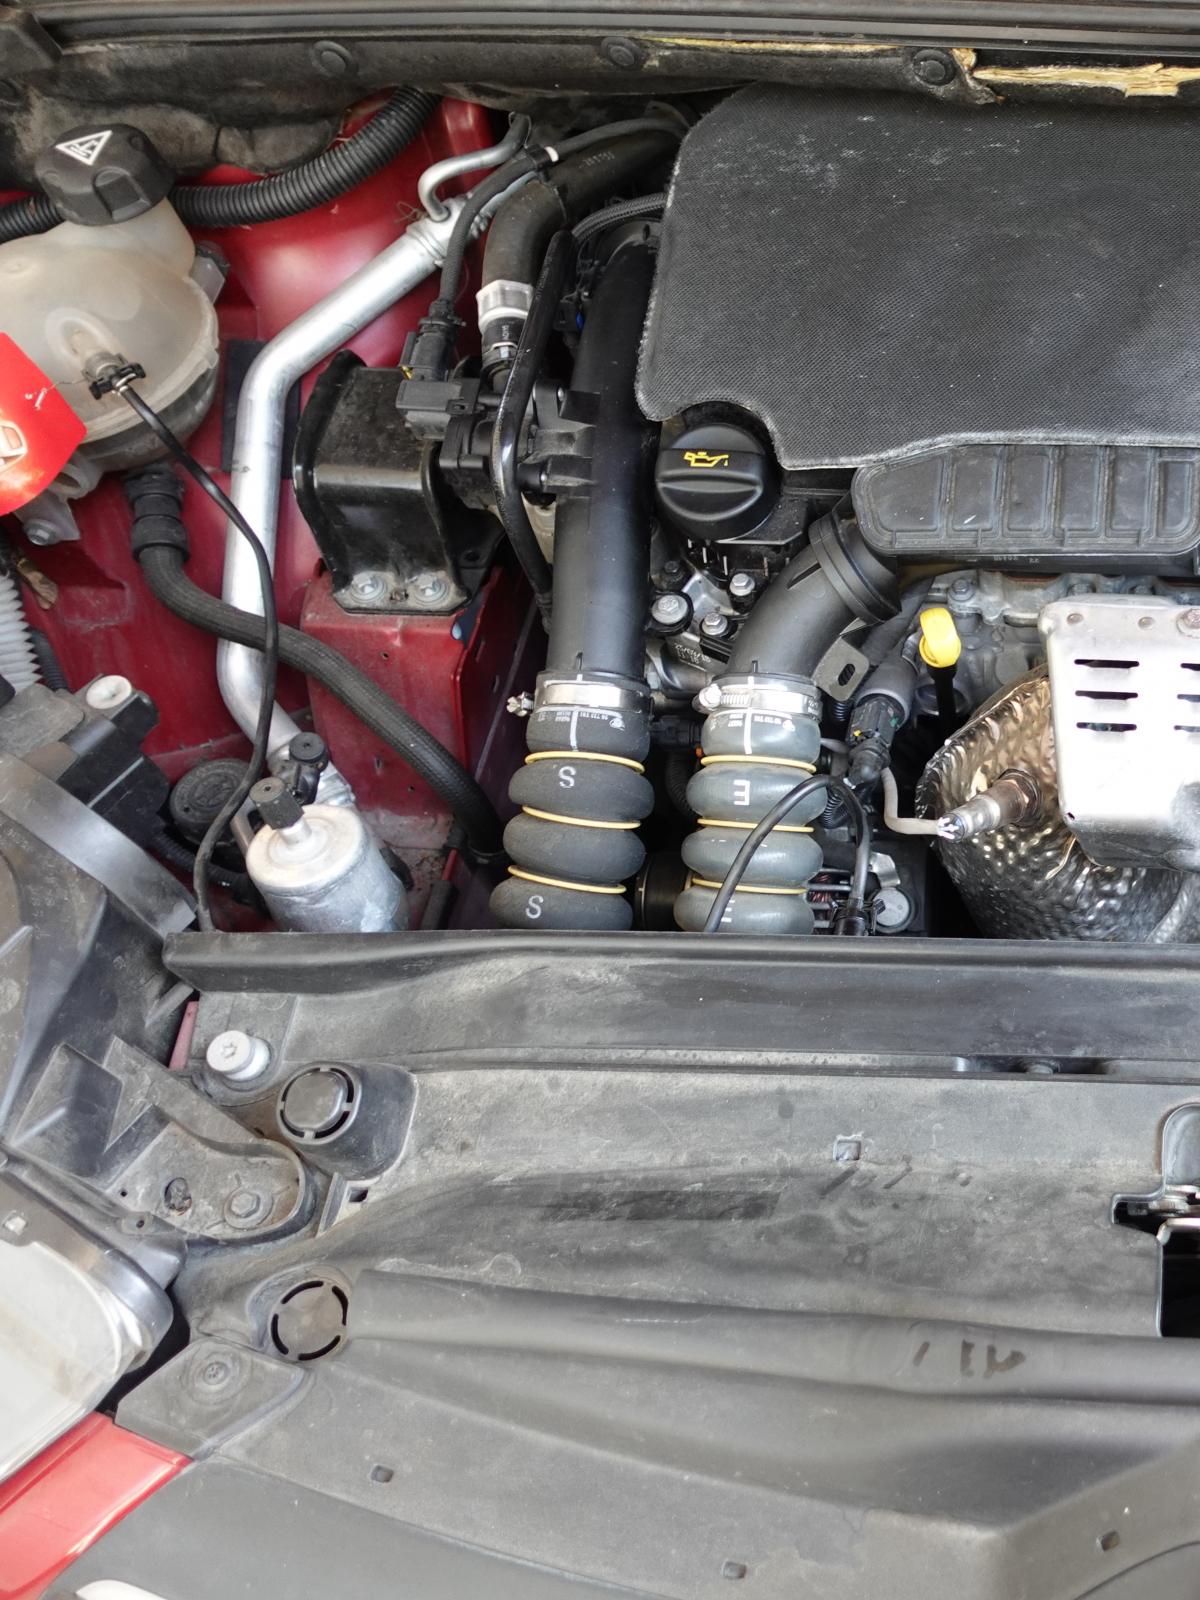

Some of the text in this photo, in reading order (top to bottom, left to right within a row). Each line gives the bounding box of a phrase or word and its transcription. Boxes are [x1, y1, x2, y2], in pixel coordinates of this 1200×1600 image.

[558, 766, 576, 788] S
[733, 780, 750, 805] E
[526, 895, 543, 919] S
